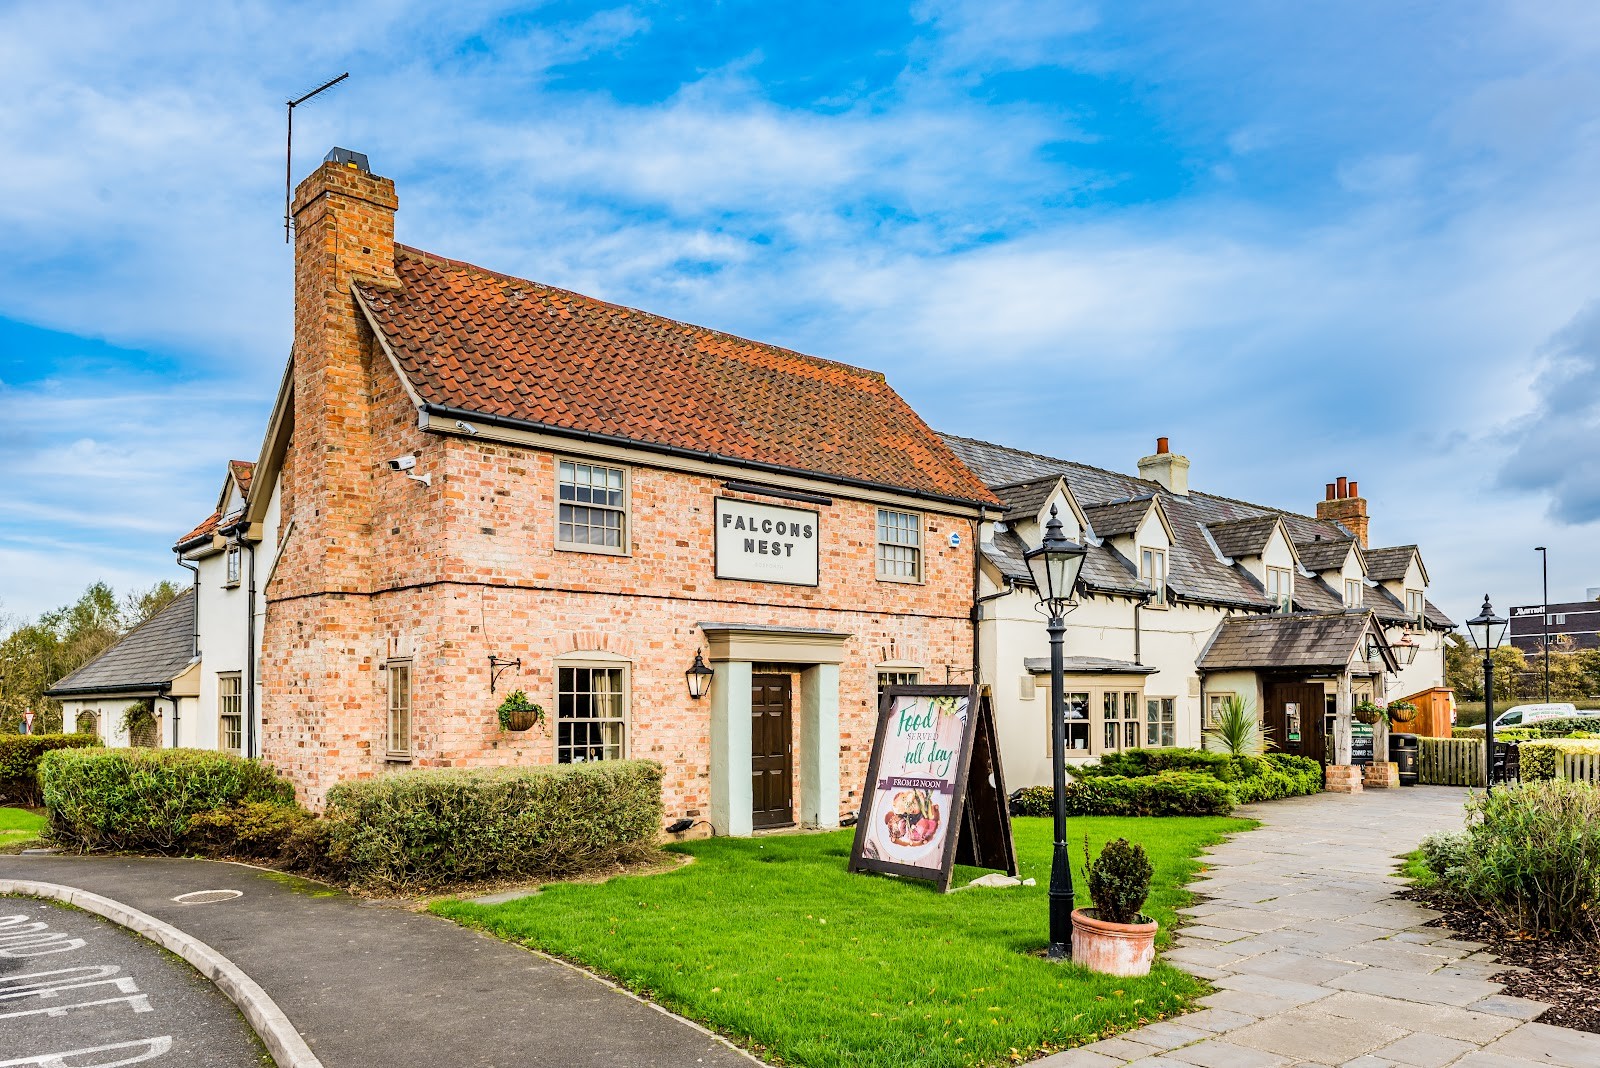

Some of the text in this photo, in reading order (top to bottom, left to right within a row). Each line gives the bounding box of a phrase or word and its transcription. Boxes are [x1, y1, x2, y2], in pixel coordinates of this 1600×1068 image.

[722, 513, 813, 539] FALCONS
[744, 538, 794, 557] NEST
[897, 701, 937, 737] Food
[907, 732, 939, 741] SERVED
[906, 742, 953, 777] all day
[893, 779, 912, 787] FROM
